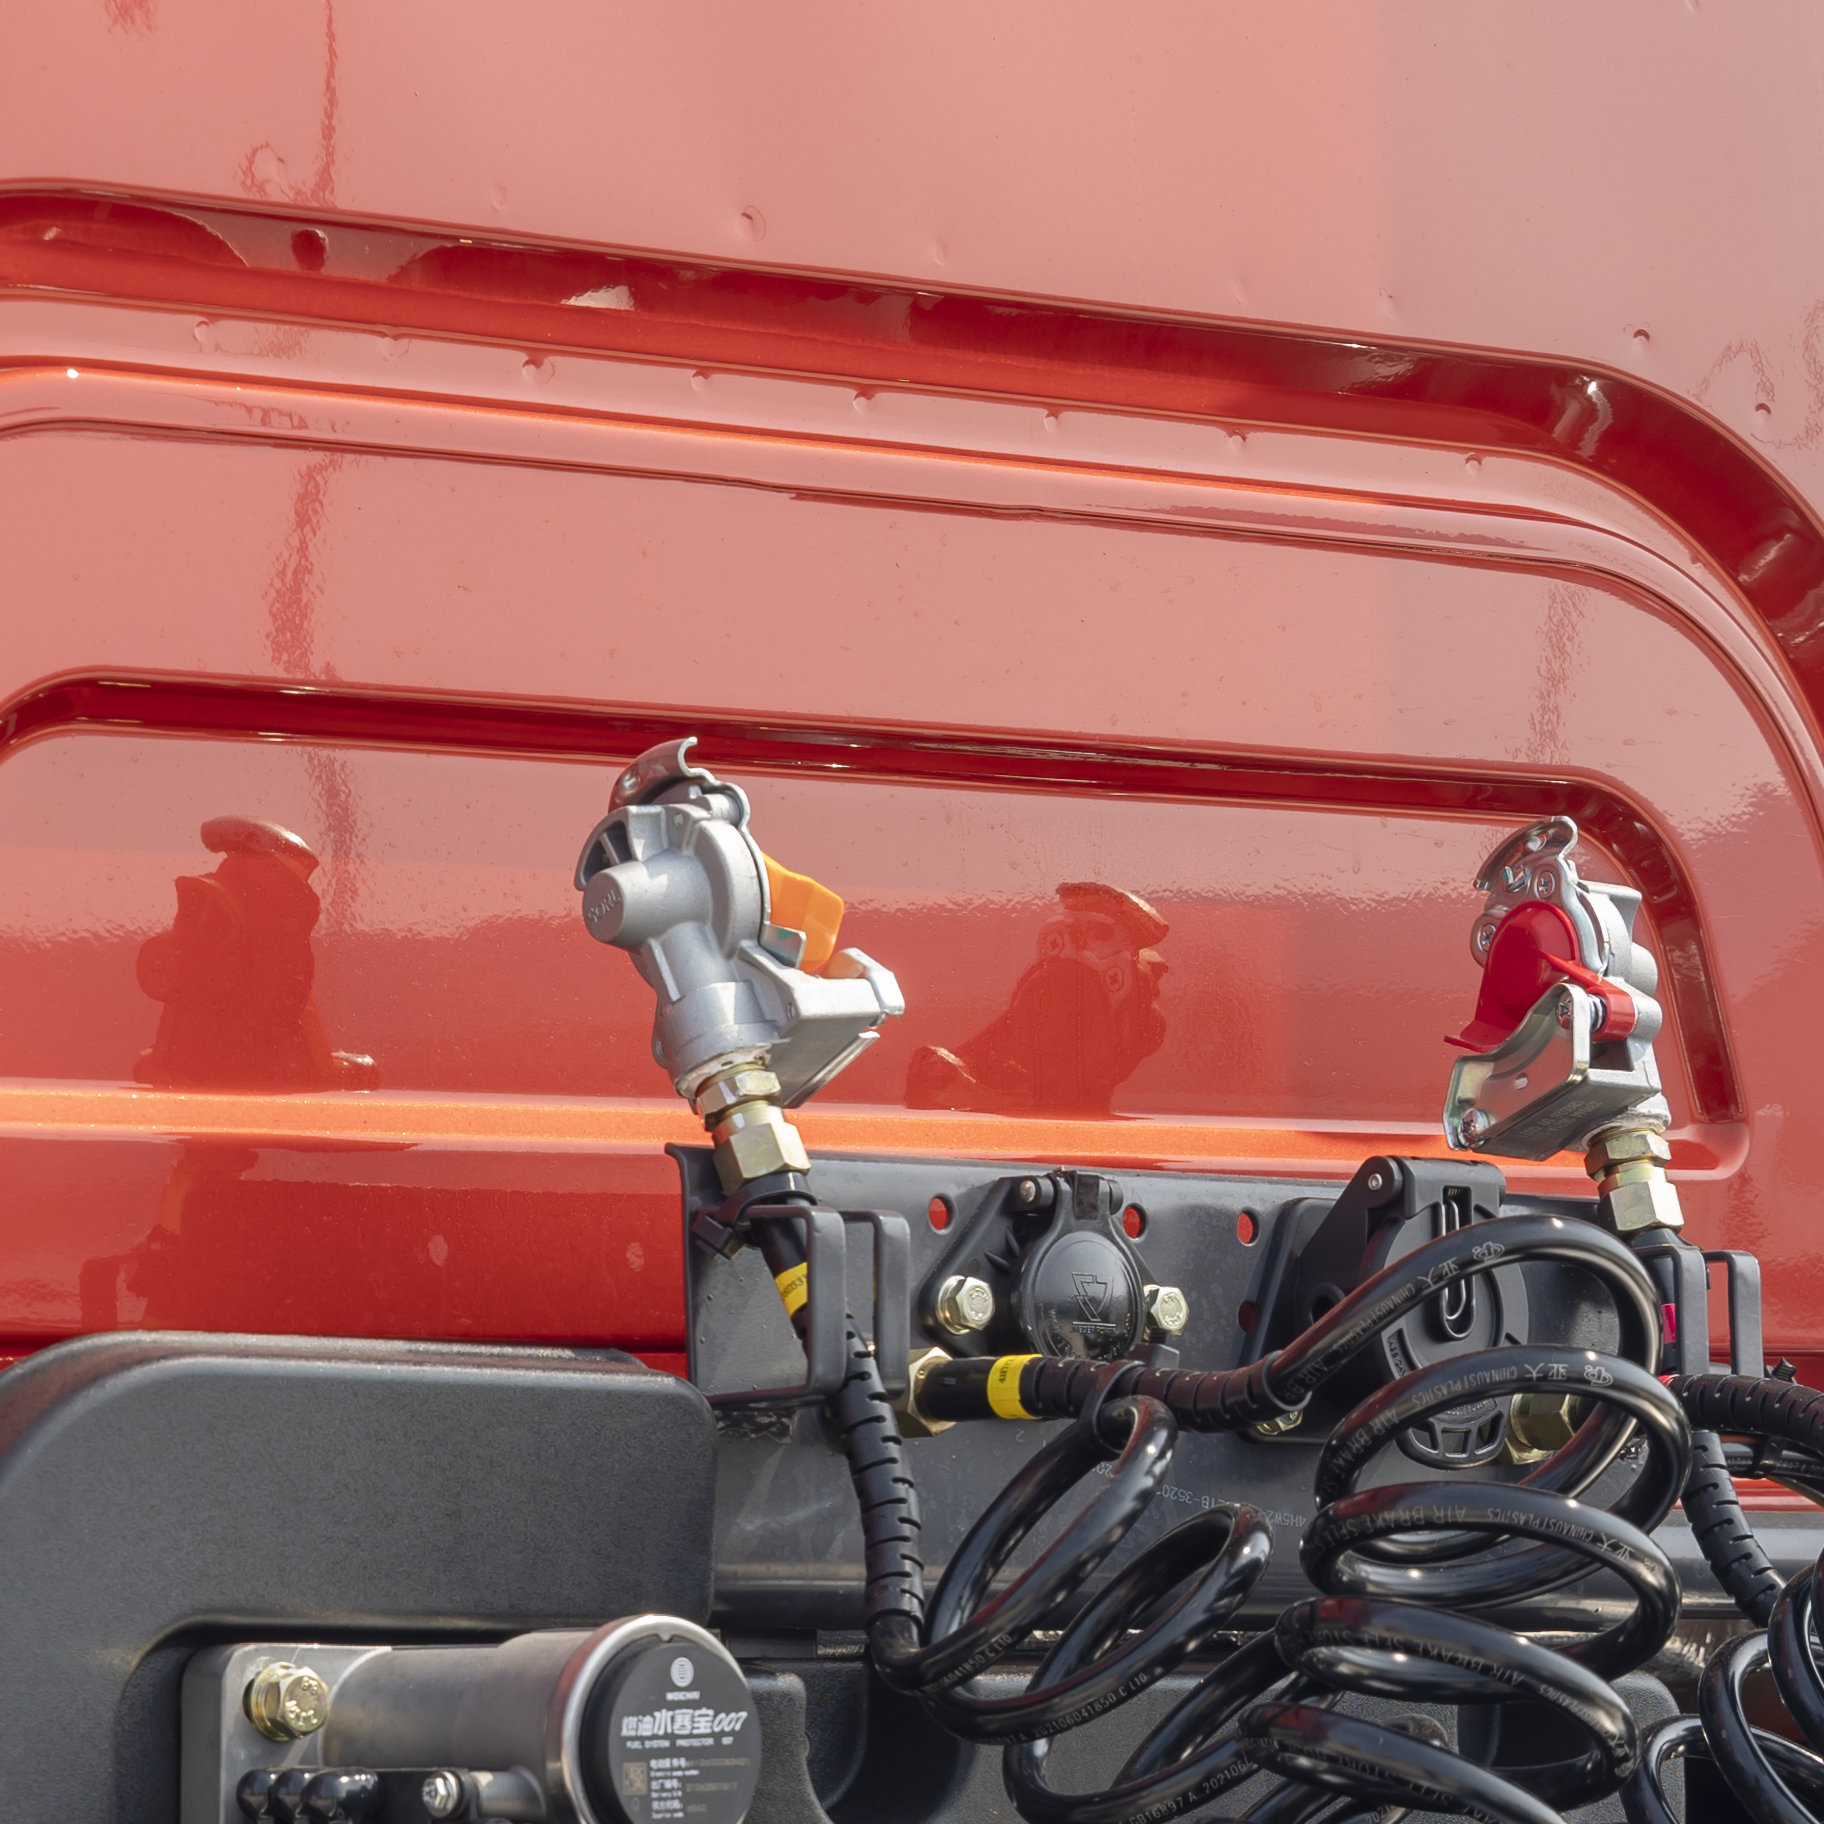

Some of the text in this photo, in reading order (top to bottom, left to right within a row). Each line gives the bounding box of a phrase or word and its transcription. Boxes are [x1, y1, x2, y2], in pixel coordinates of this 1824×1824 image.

[586, 885, 623, 923] SORL
[1370, 1405, 1399, 1435] AIR
[1360, 1505, 1425, 1533] BRAKE
[1432, 1504, 1466, 1524] AIR
